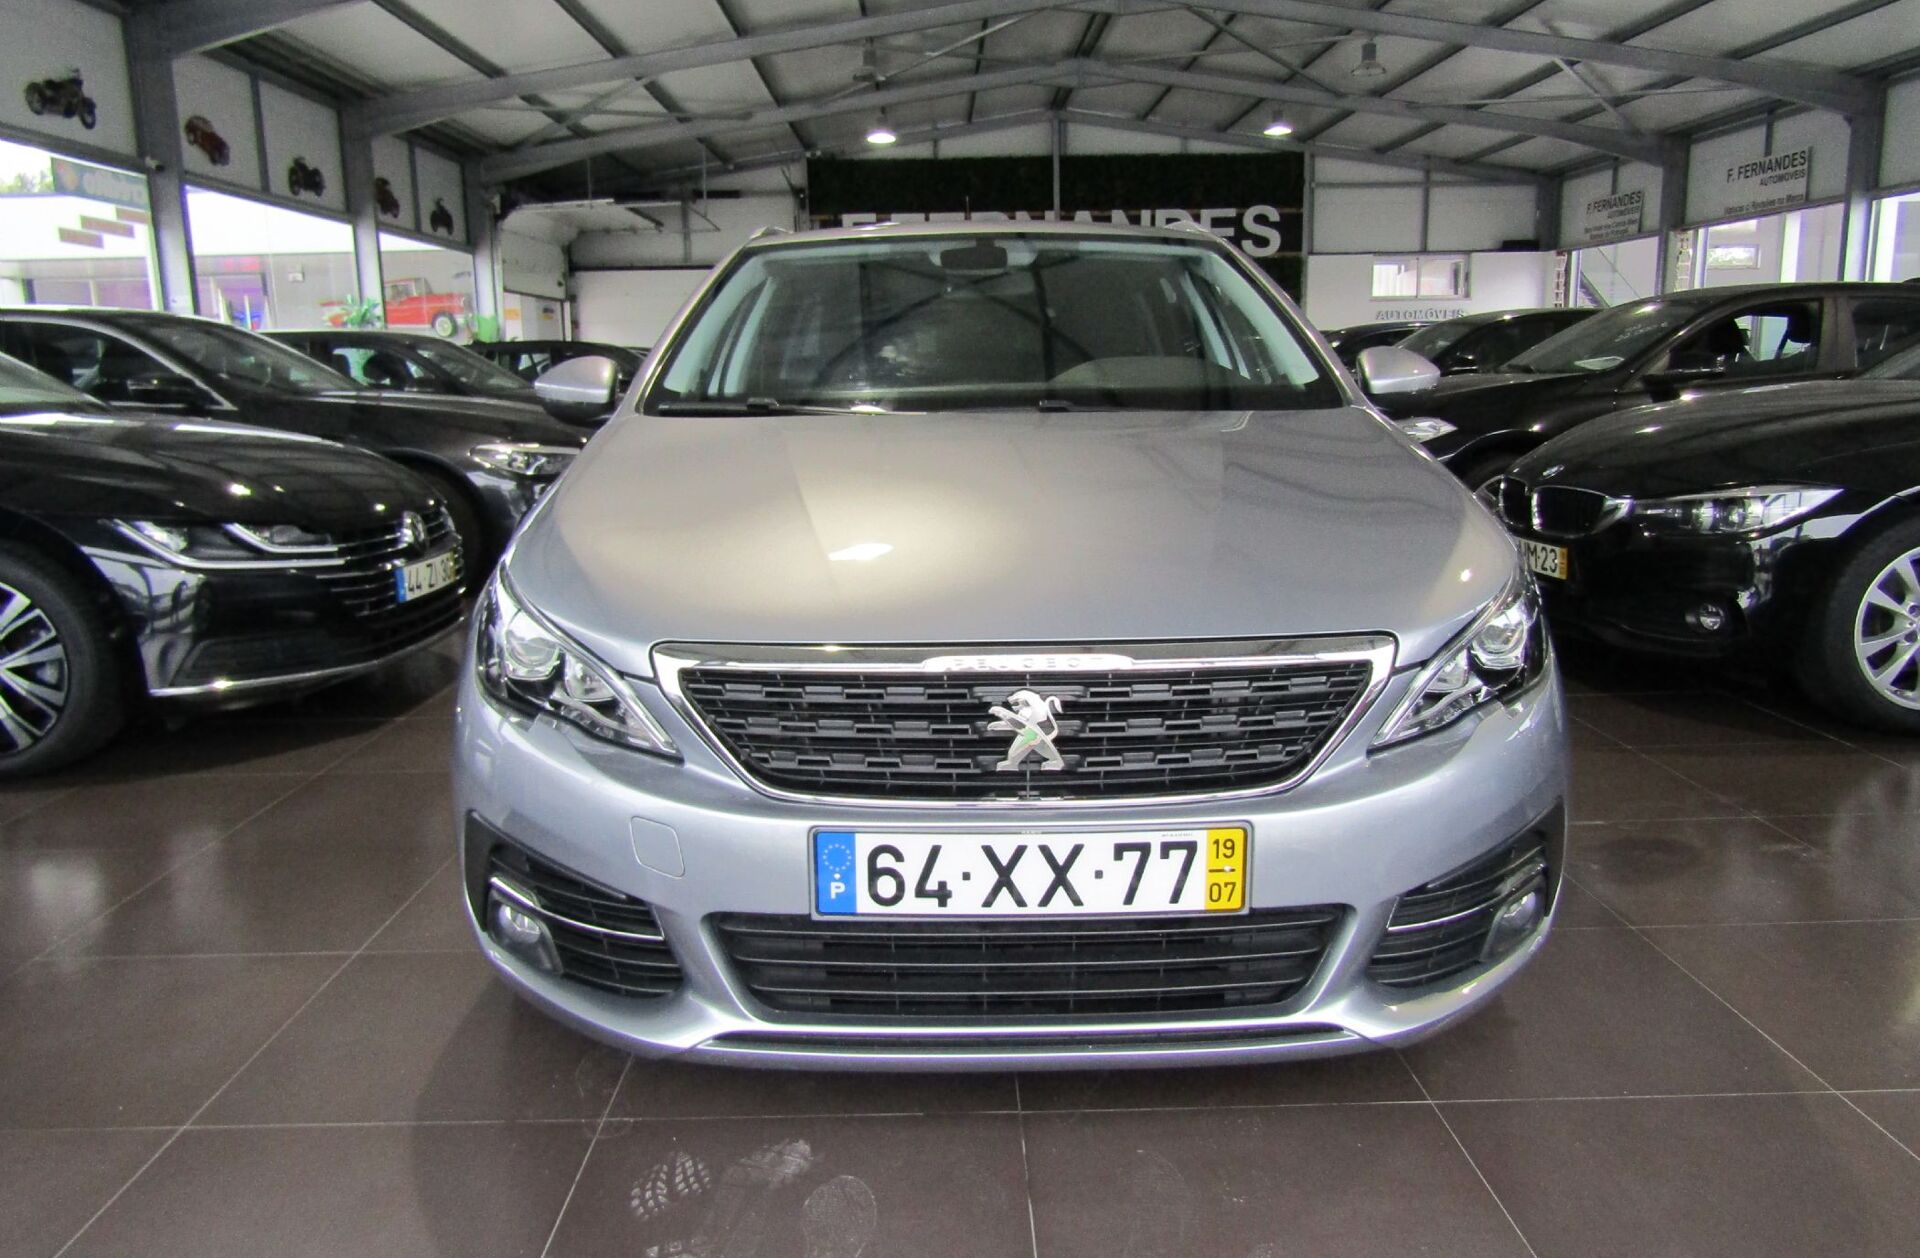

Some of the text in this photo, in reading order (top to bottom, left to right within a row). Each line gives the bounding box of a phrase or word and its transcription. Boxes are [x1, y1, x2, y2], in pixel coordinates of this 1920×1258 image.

[1738, 150, 1807, 180] FERNANDES
[1594, 190, 1642, 212] FERNANDES
[951, 656, 1105, 669] PEGEOT
[1212, 838, 1235, 860] 19
[830, 881, 846, 899] P
[1209, 882, 1237, 903] 07
